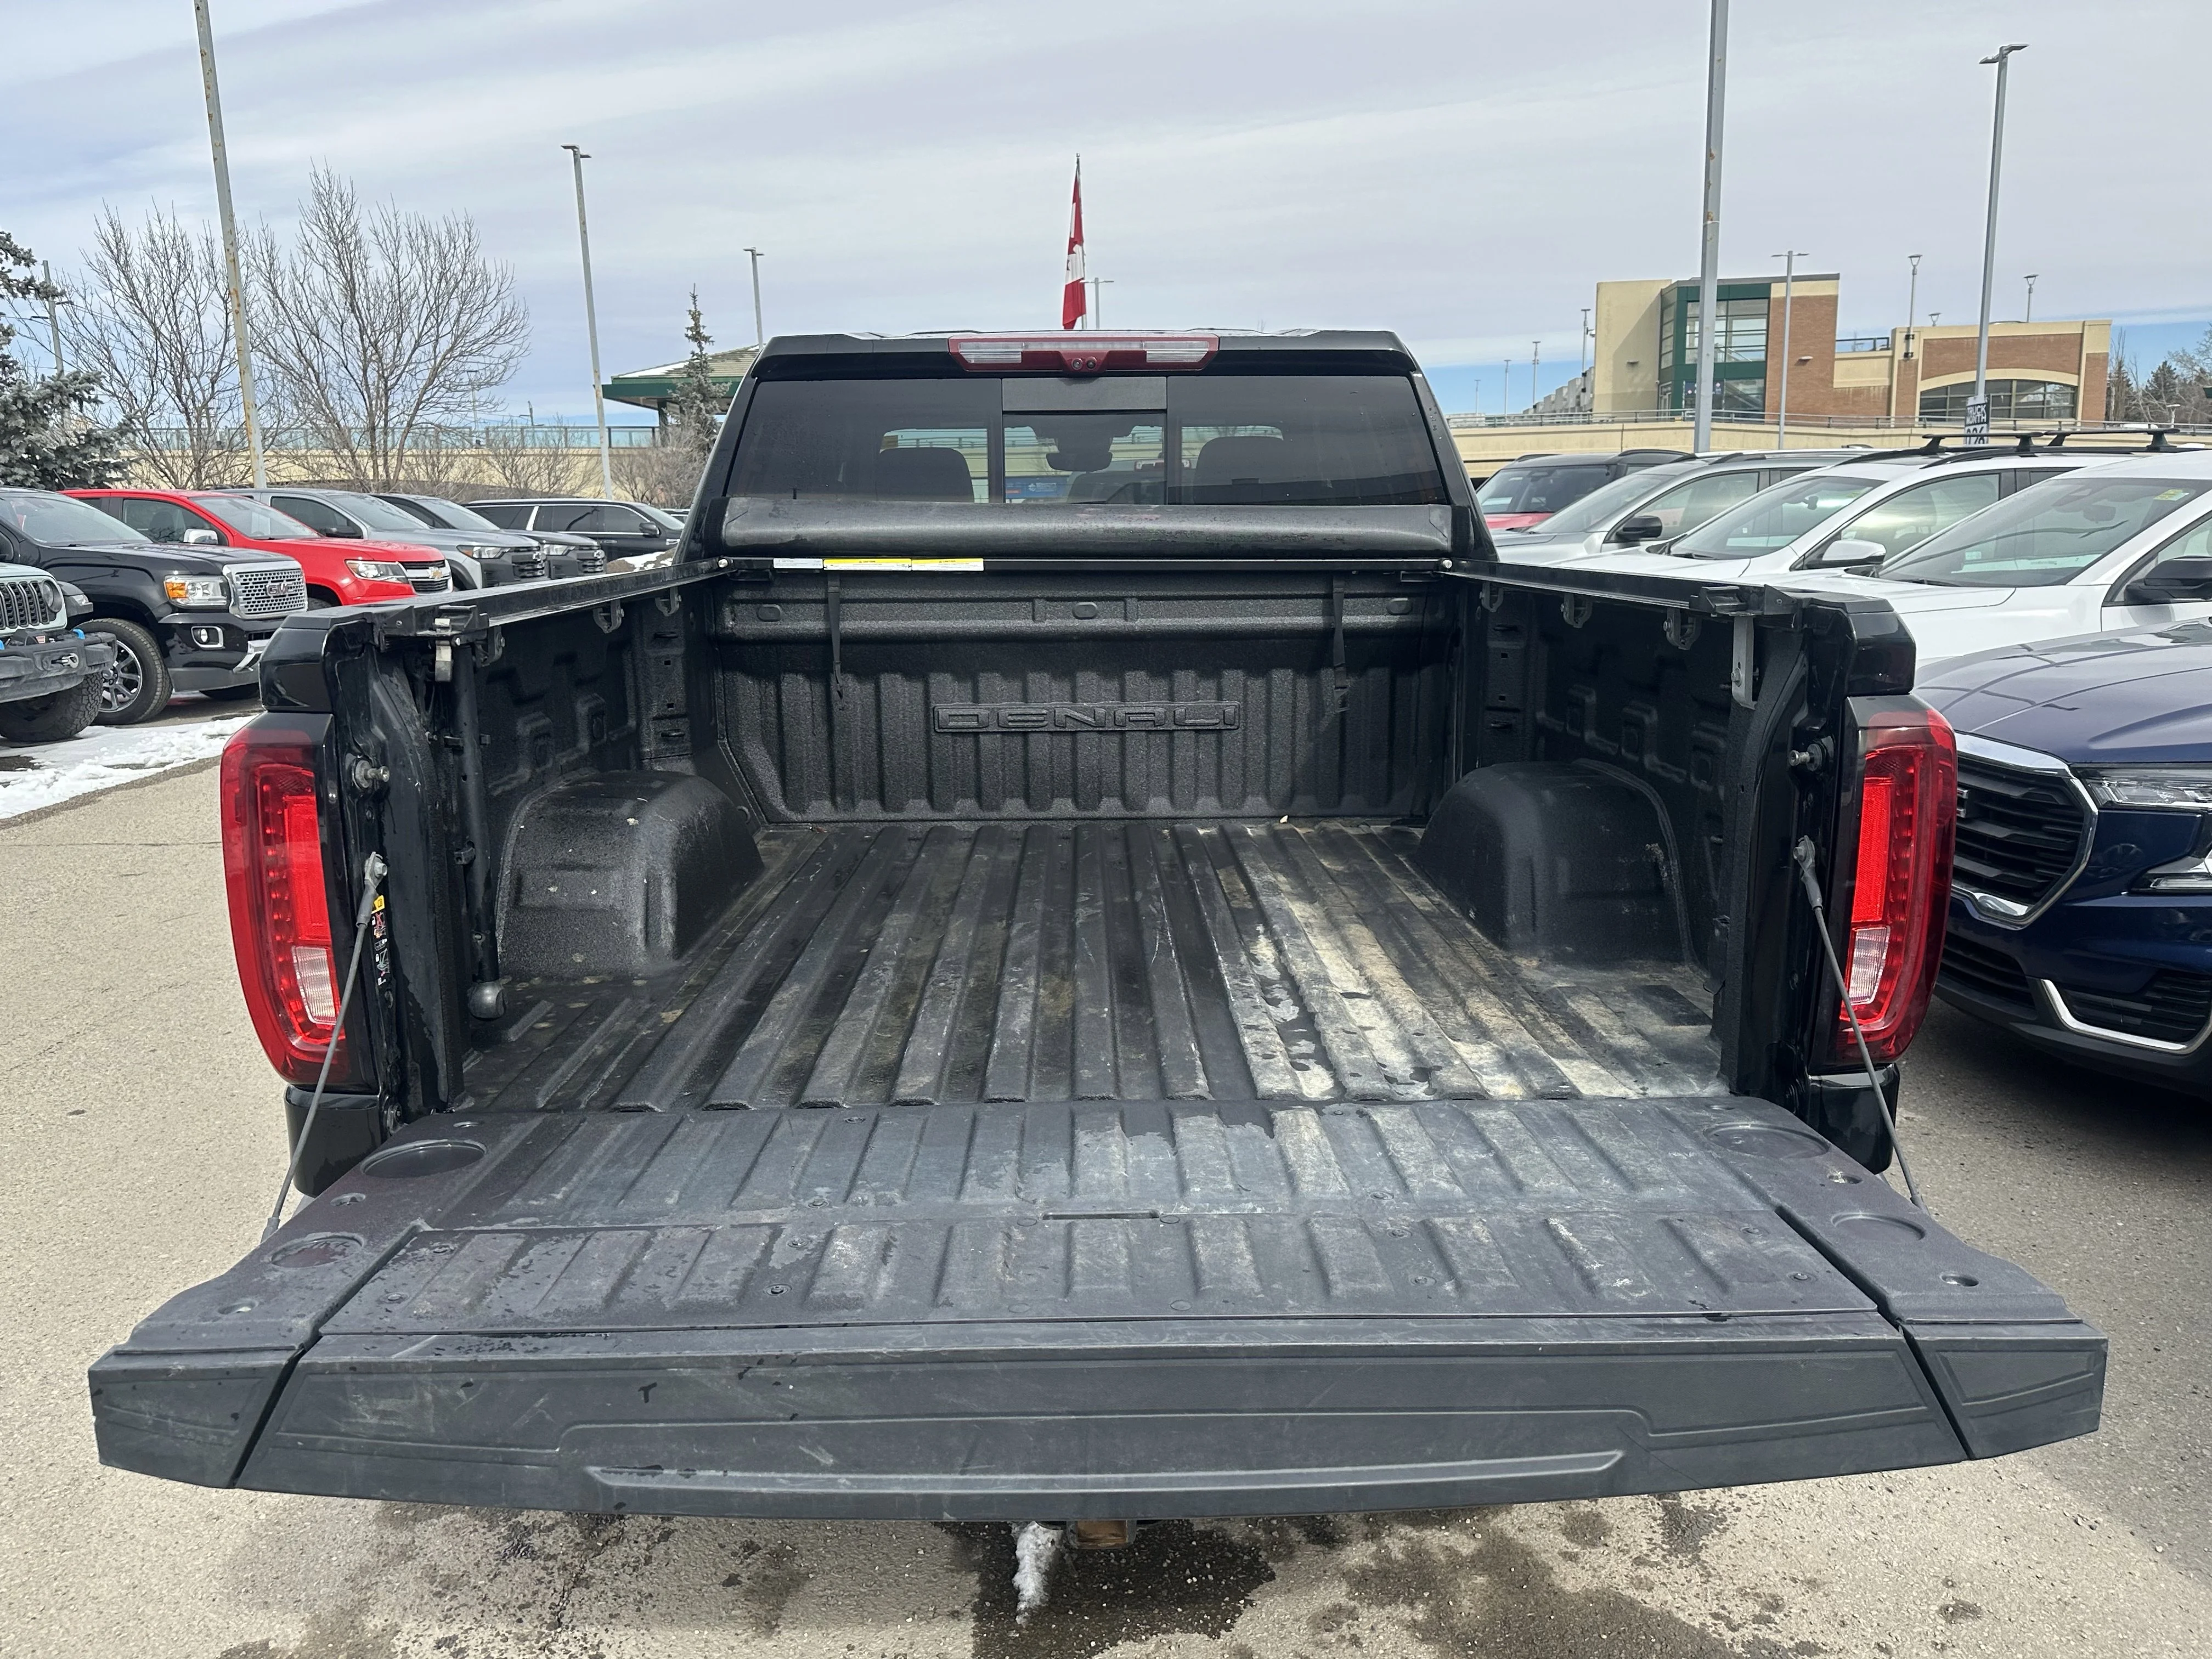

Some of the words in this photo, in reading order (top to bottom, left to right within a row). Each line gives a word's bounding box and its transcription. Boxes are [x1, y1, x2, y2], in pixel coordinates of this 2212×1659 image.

[1967, 404, 1987, 416] TRUCK
[1966, 414, 1987, 425] MONTH
[266, 583, 295, 596] GMC
[937, 707, 1235, 729] DENALI
